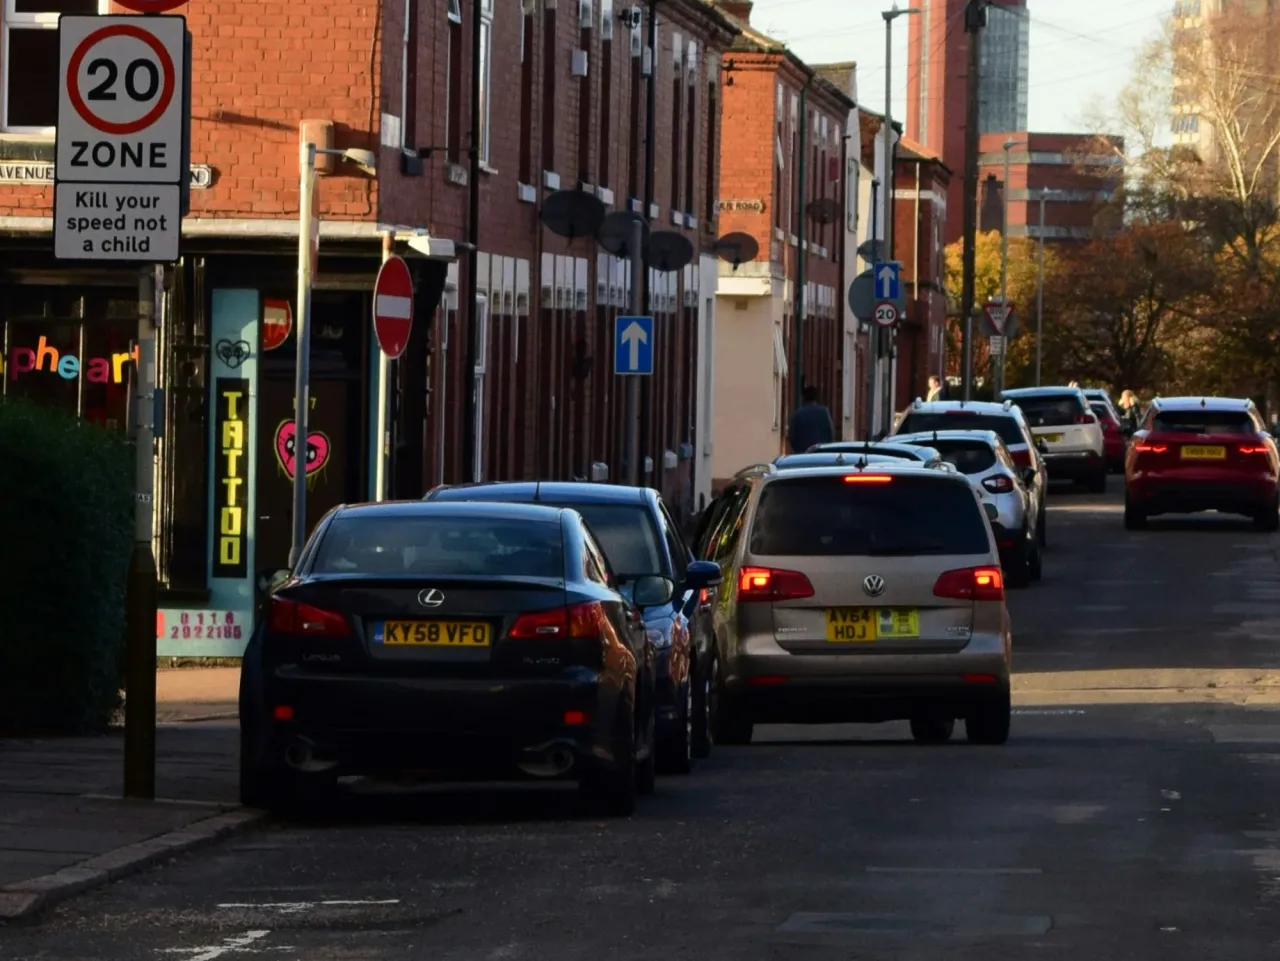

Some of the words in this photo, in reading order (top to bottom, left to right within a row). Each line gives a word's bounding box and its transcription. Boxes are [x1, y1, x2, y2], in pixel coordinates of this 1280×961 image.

[87, 58, 160, 102] 20
[70, 141, 168, 169] ZONE
[76, 192, 108, 208] Kill
[116, 195, 160, 212] your
[67, 214, 126, 232] speed
[134, 214, 168, 231] not
[82, 239, 94, 252] a
[101, 236, 150, 253] child
[877, 309, 895, 320] 20
[220, 391, 243, 565] TATTOO
[385, 623, 440, 642] KY58
[446, 624, 486, 643] VFO
